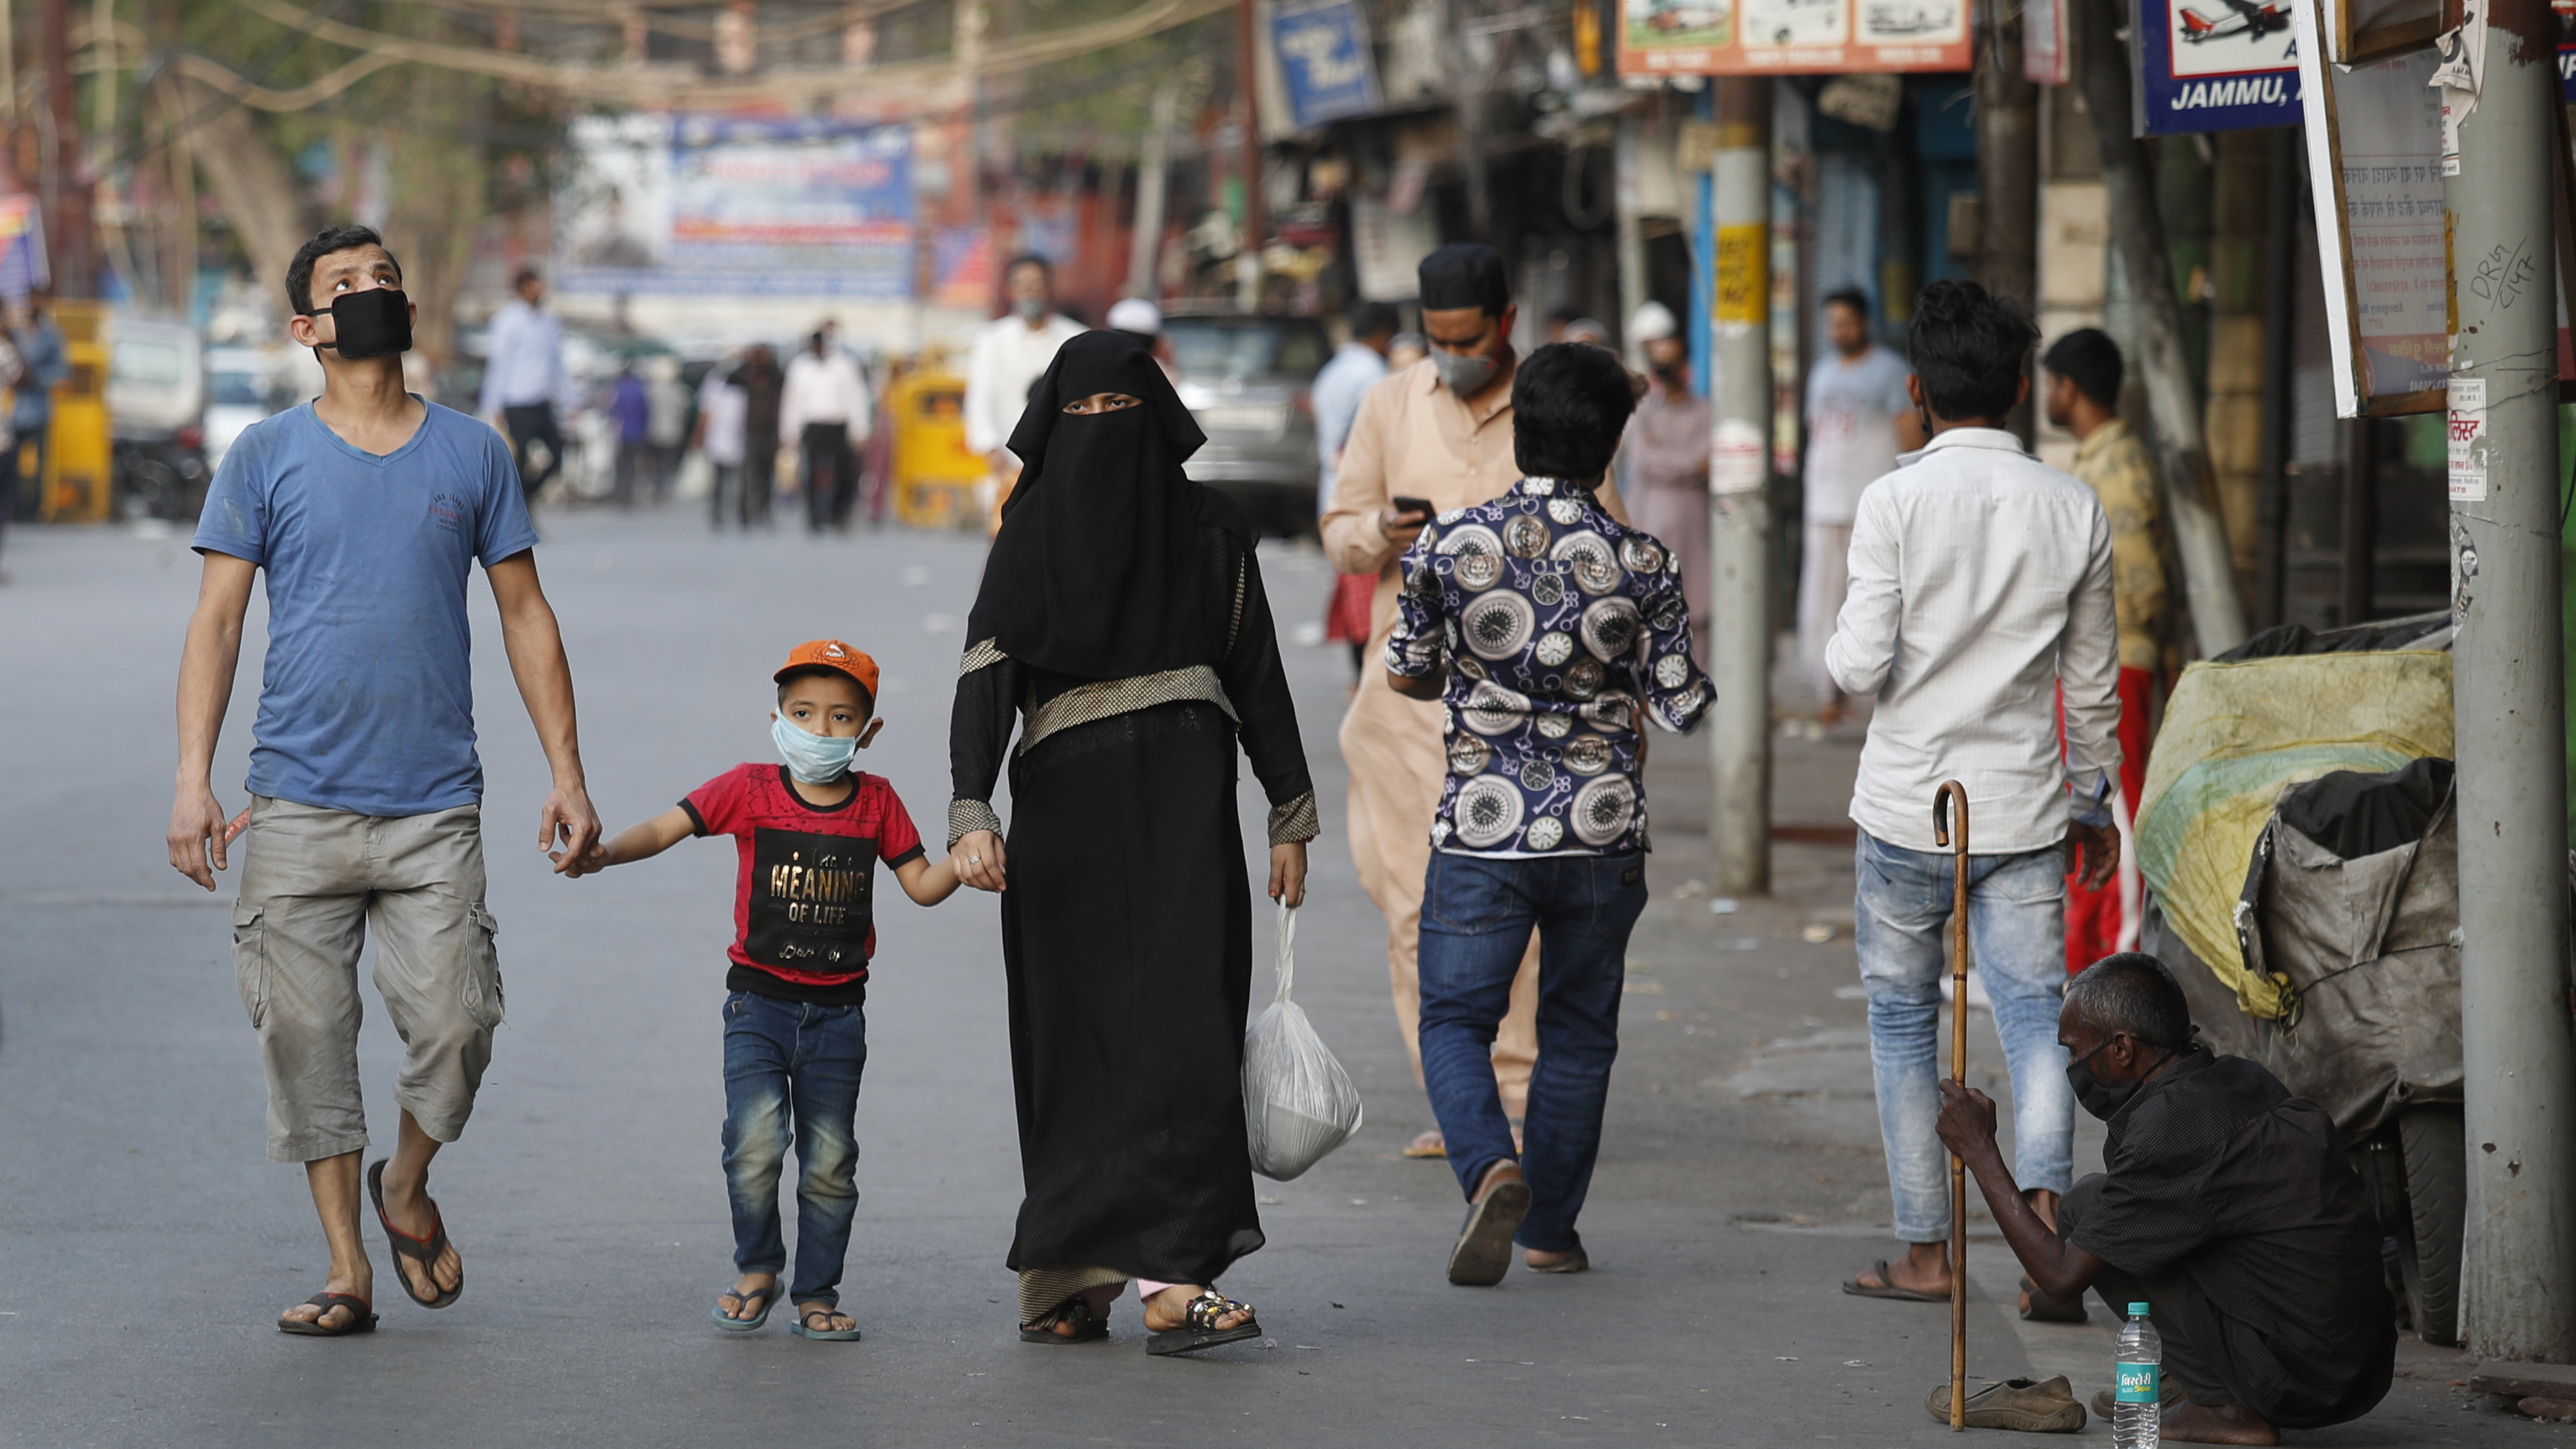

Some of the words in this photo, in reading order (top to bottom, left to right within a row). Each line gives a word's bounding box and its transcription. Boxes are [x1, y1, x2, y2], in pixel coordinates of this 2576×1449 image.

[2171, 76, 2287, 110] JAMMU,
[771, 864, 865, 903] MEANING
[789, 902, 809, 922] OF
[814, 904, 846, 925] LIFE
